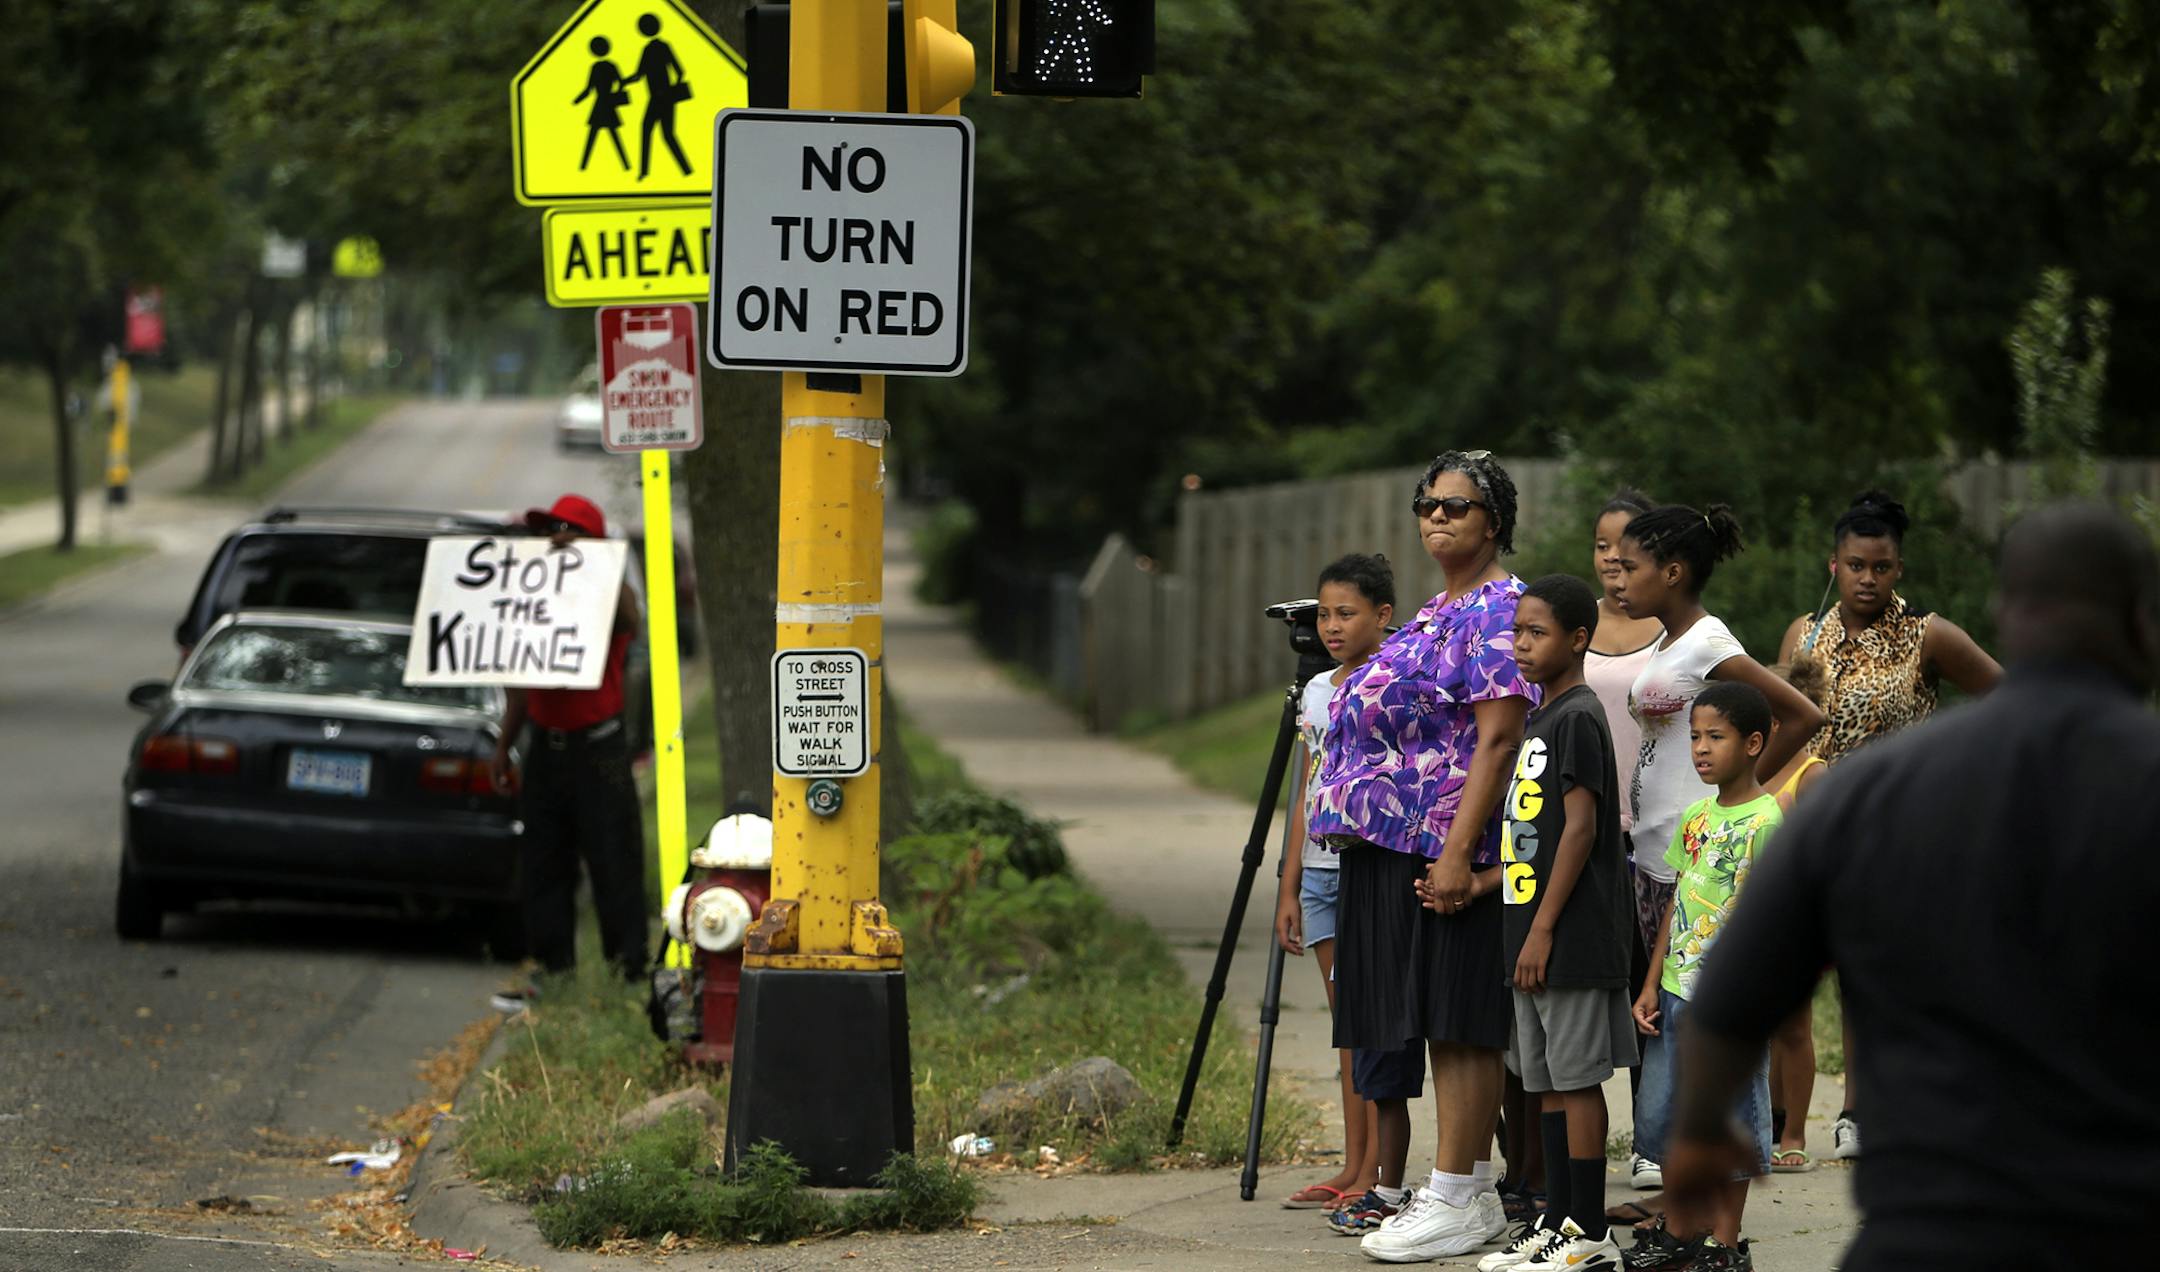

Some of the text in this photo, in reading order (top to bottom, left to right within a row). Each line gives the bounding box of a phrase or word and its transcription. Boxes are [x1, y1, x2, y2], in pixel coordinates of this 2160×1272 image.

[802, 146, 886, 193] NO
[771, 216, 914, 265] TURN
[736, 285, 944, 336] ON RED
[629, 369, 671, 387] SNOW
[610, 389, 692, 410] EMERGENCY
[627, 410, 674, 429] ROUTE
[491, 598, 553, 625] THE
[787, 661, 853, 674] TO CROSS
[796, 678, 845, 690] STREET
[783, 705, 858, 717] PUSH BUTTON
[788, 721, 854, 734] WAIT FOR
[799, 738, 842, 750] WALK
[796, 754, 846, 766] SIGNAL
